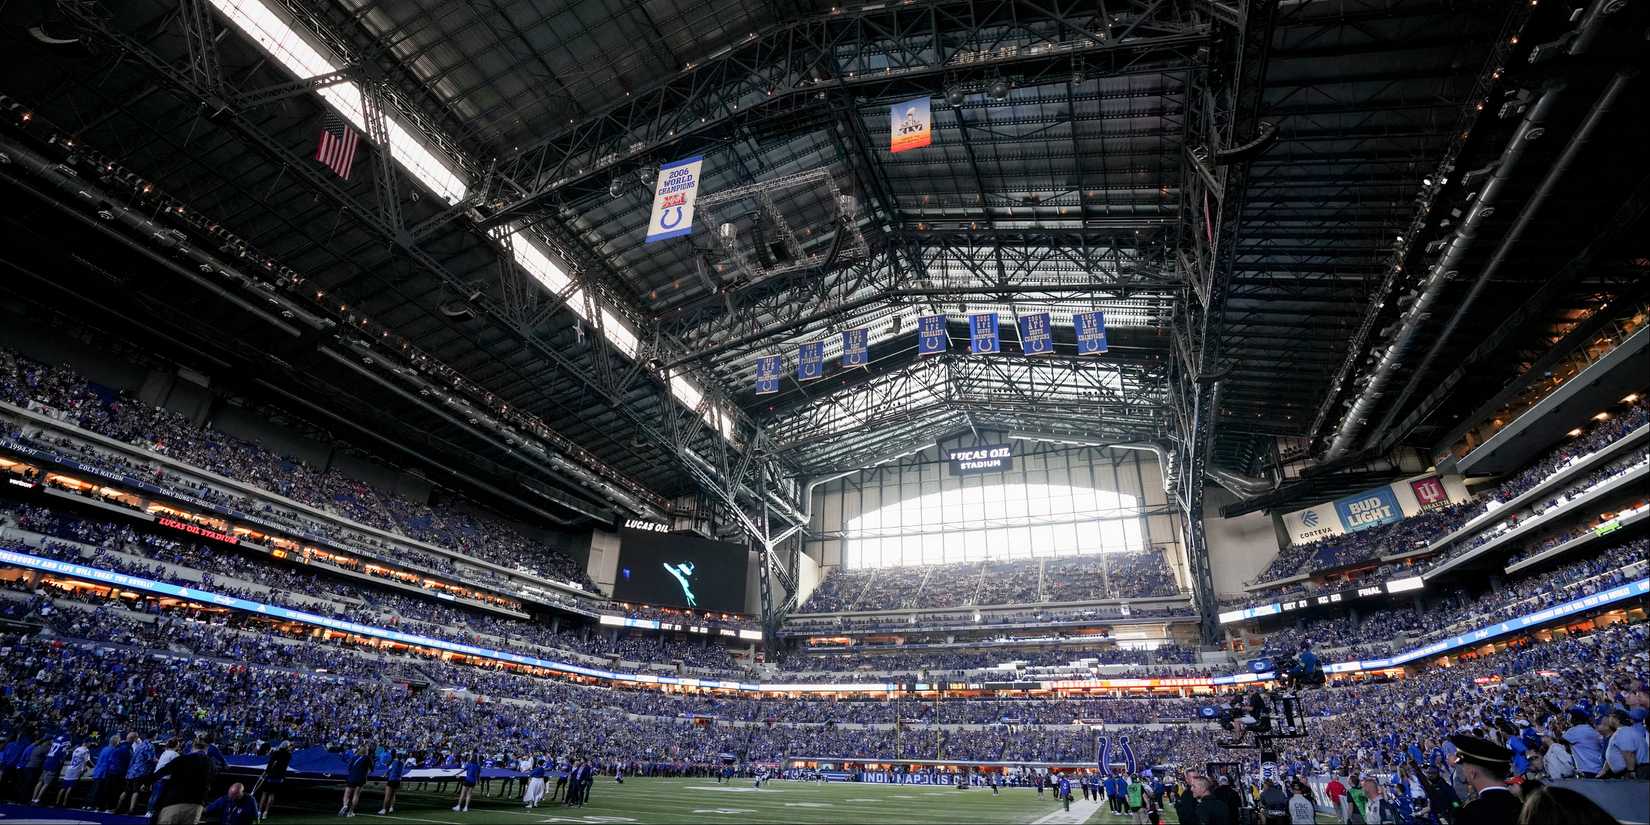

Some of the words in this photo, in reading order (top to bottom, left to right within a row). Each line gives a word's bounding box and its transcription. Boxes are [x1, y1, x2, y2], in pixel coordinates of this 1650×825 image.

[669, 168, 689, 179] 2006
[664, 175, 692, 187] WORLD
[659, 181, 695, 195] CHAMPIONS
[950, 449, 988, 460] LUCAS
[990, 447, 1010, 458] OIL
[960, 460, 1001, 470] STADIUM
[78, 463, 99, 474] COLTS
[99, 471, 124, 481] NATION
[160, 488, 174, 497] TONY
[1349, 497, 1382, 514] BUD
[1348, 505, 1393, 527] LIGHT
[159, 518, 186, 530] LUCAS
[186, 524, 200, 534] OIL
[200, 529, 239, 544] STADIUM
[625, 519, 655, 531] LUCAS
[655, 523, 669, 533] OIL
[1300, 527, 1332, 539] CORTEVA
[1358, 586, 1382, 597] FINAL
